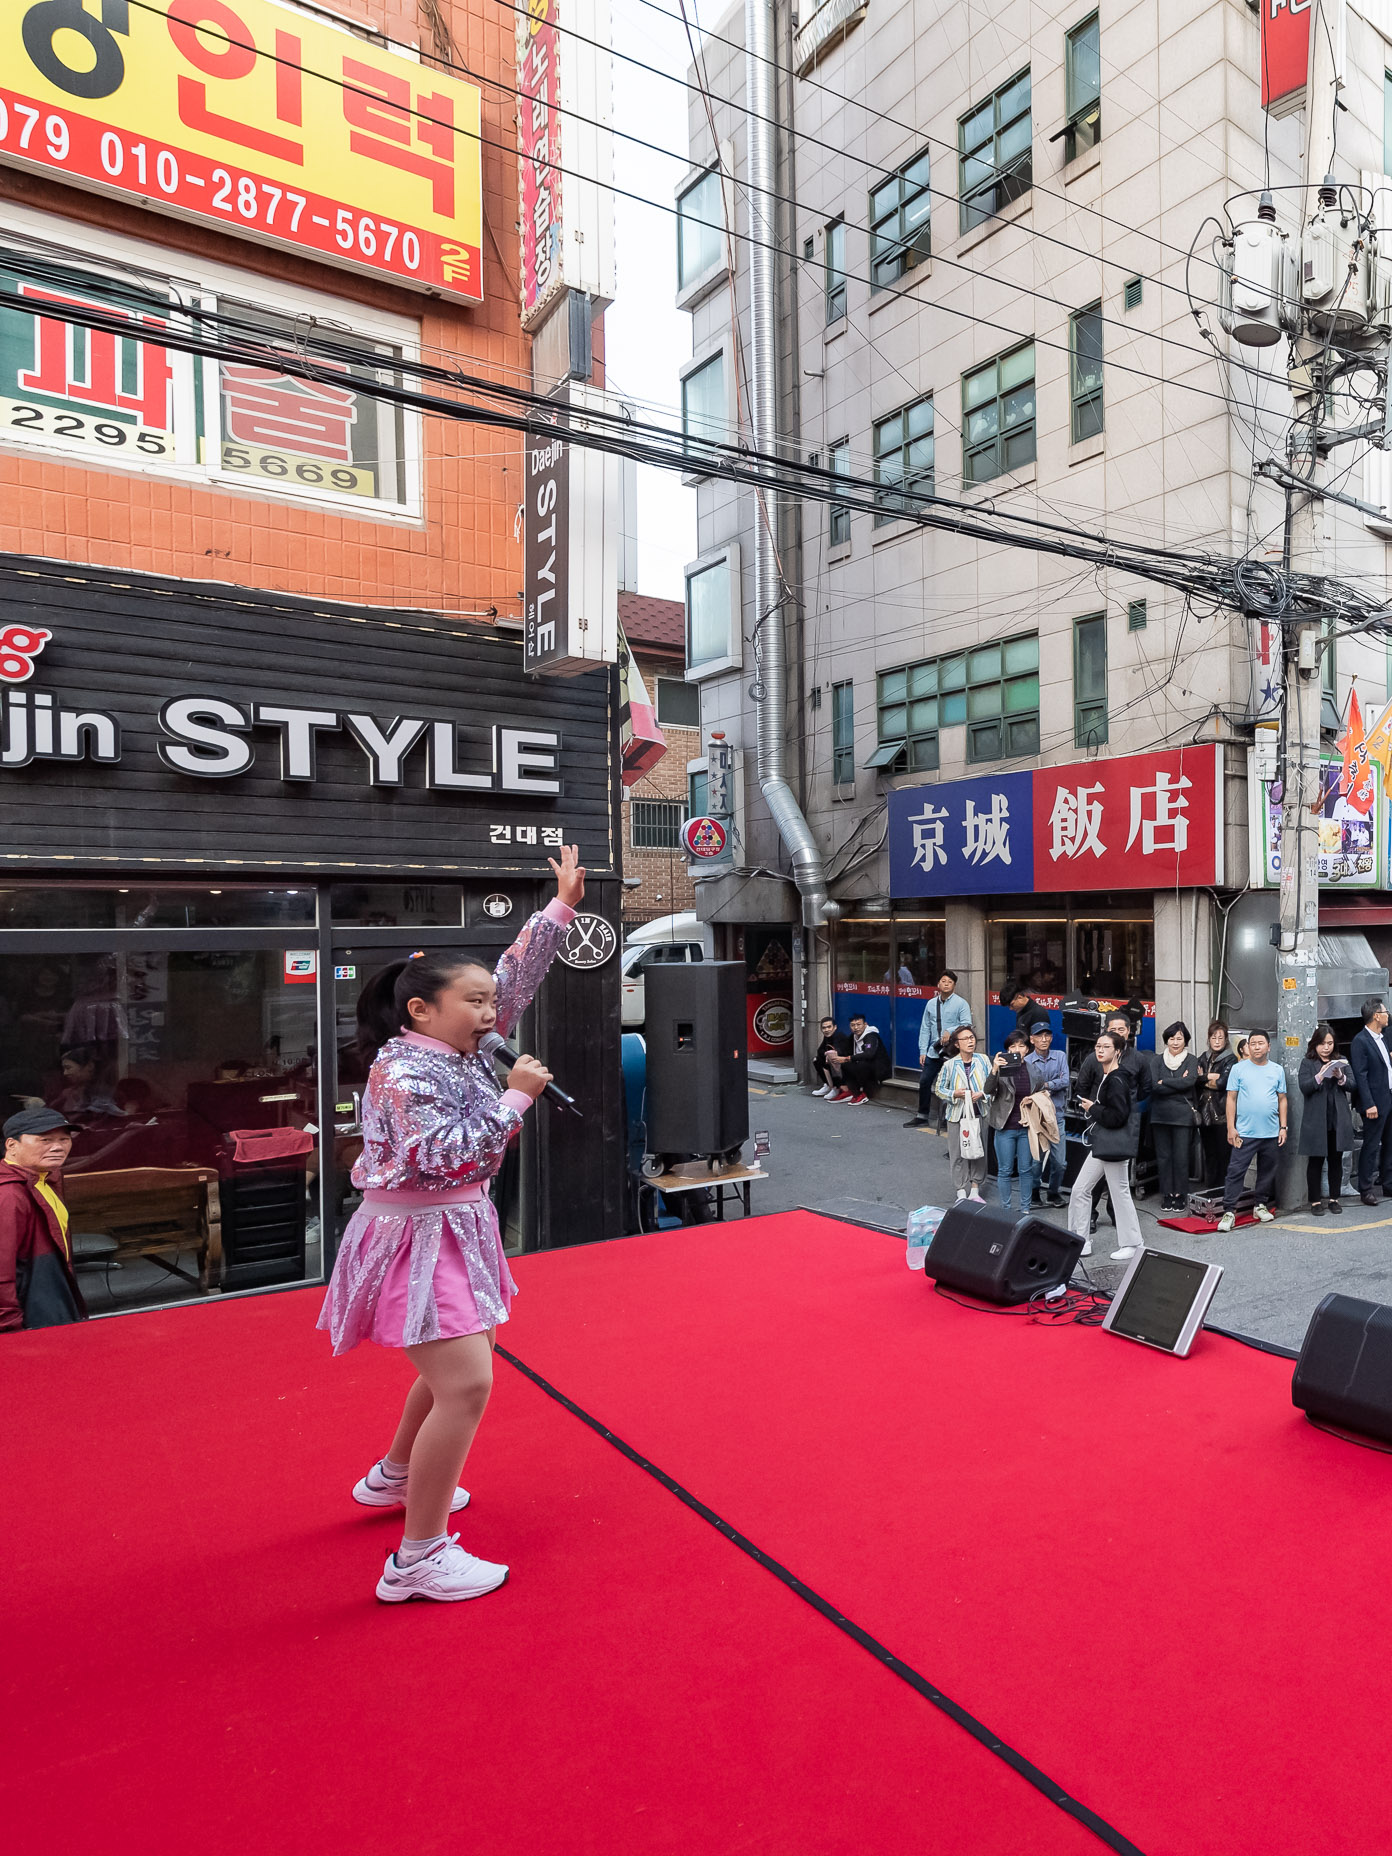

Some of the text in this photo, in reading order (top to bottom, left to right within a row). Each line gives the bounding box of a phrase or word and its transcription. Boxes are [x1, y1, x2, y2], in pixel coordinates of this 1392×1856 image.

[166, 0, 456, 219] 인력
[532, 42, 552, 286] 노래연습장
[100, 131, 421, 270] 010-2877-5670
[440, 243, 470, 283] 2F
[11, 405, 358, 490] 2295 5669
[537, 479, 557, 657] STYLE
[165, 697, 561, 794] STYLE
[489, 824, 564, 846] 건대점
